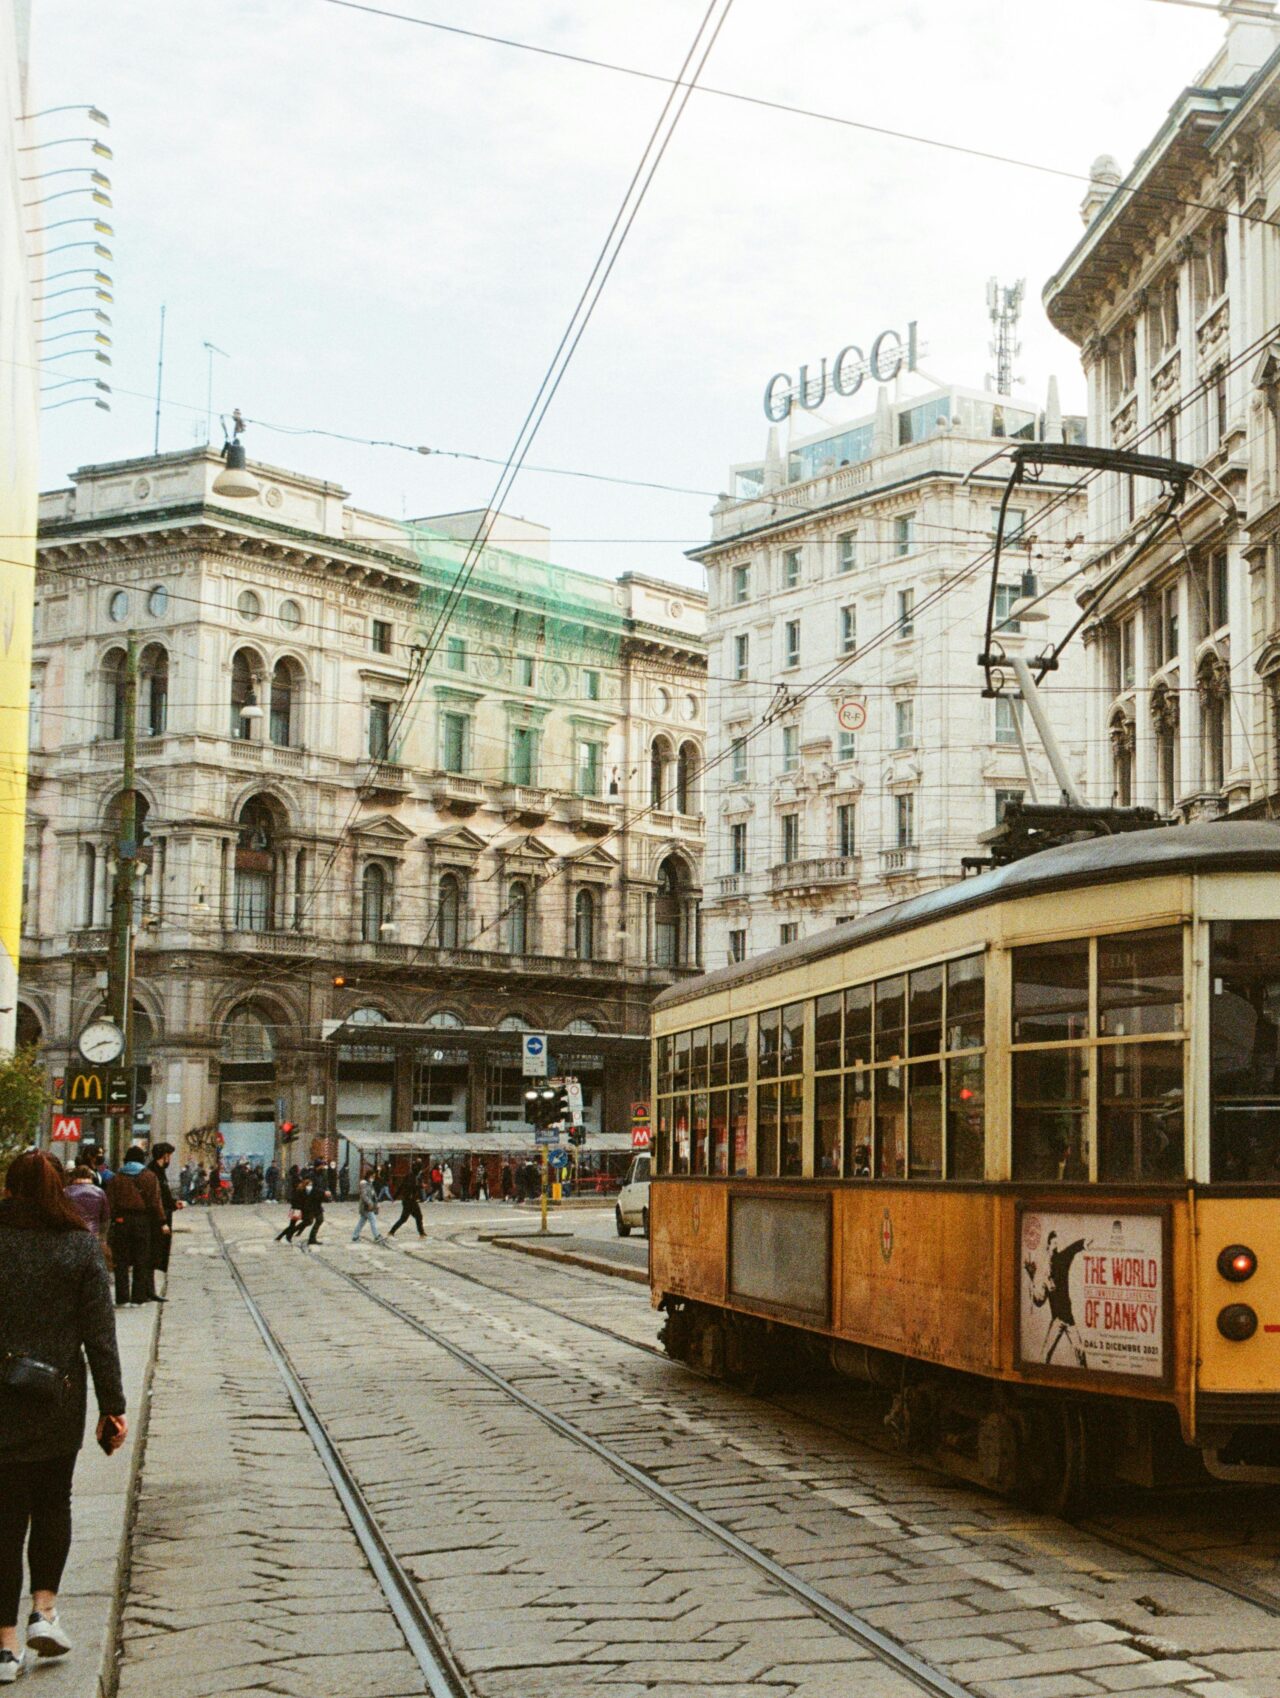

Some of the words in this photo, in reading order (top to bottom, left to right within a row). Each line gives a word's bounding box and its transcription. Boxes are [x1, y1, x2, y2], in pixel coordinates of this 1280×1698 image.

[764, 321, 918, 423] GUCCI
[1083, 1256, 1107, 1285] THE
[1112, 1257, 1158, 1288] WORLD
[1085, 1300, 1100, 1328] OF
[1104, 1301, 1158, 1333] BANKSY
[1084, 1340, 1098, 1349] DAL
[1106, 1342, 1141, 1353] DICEMBRE
